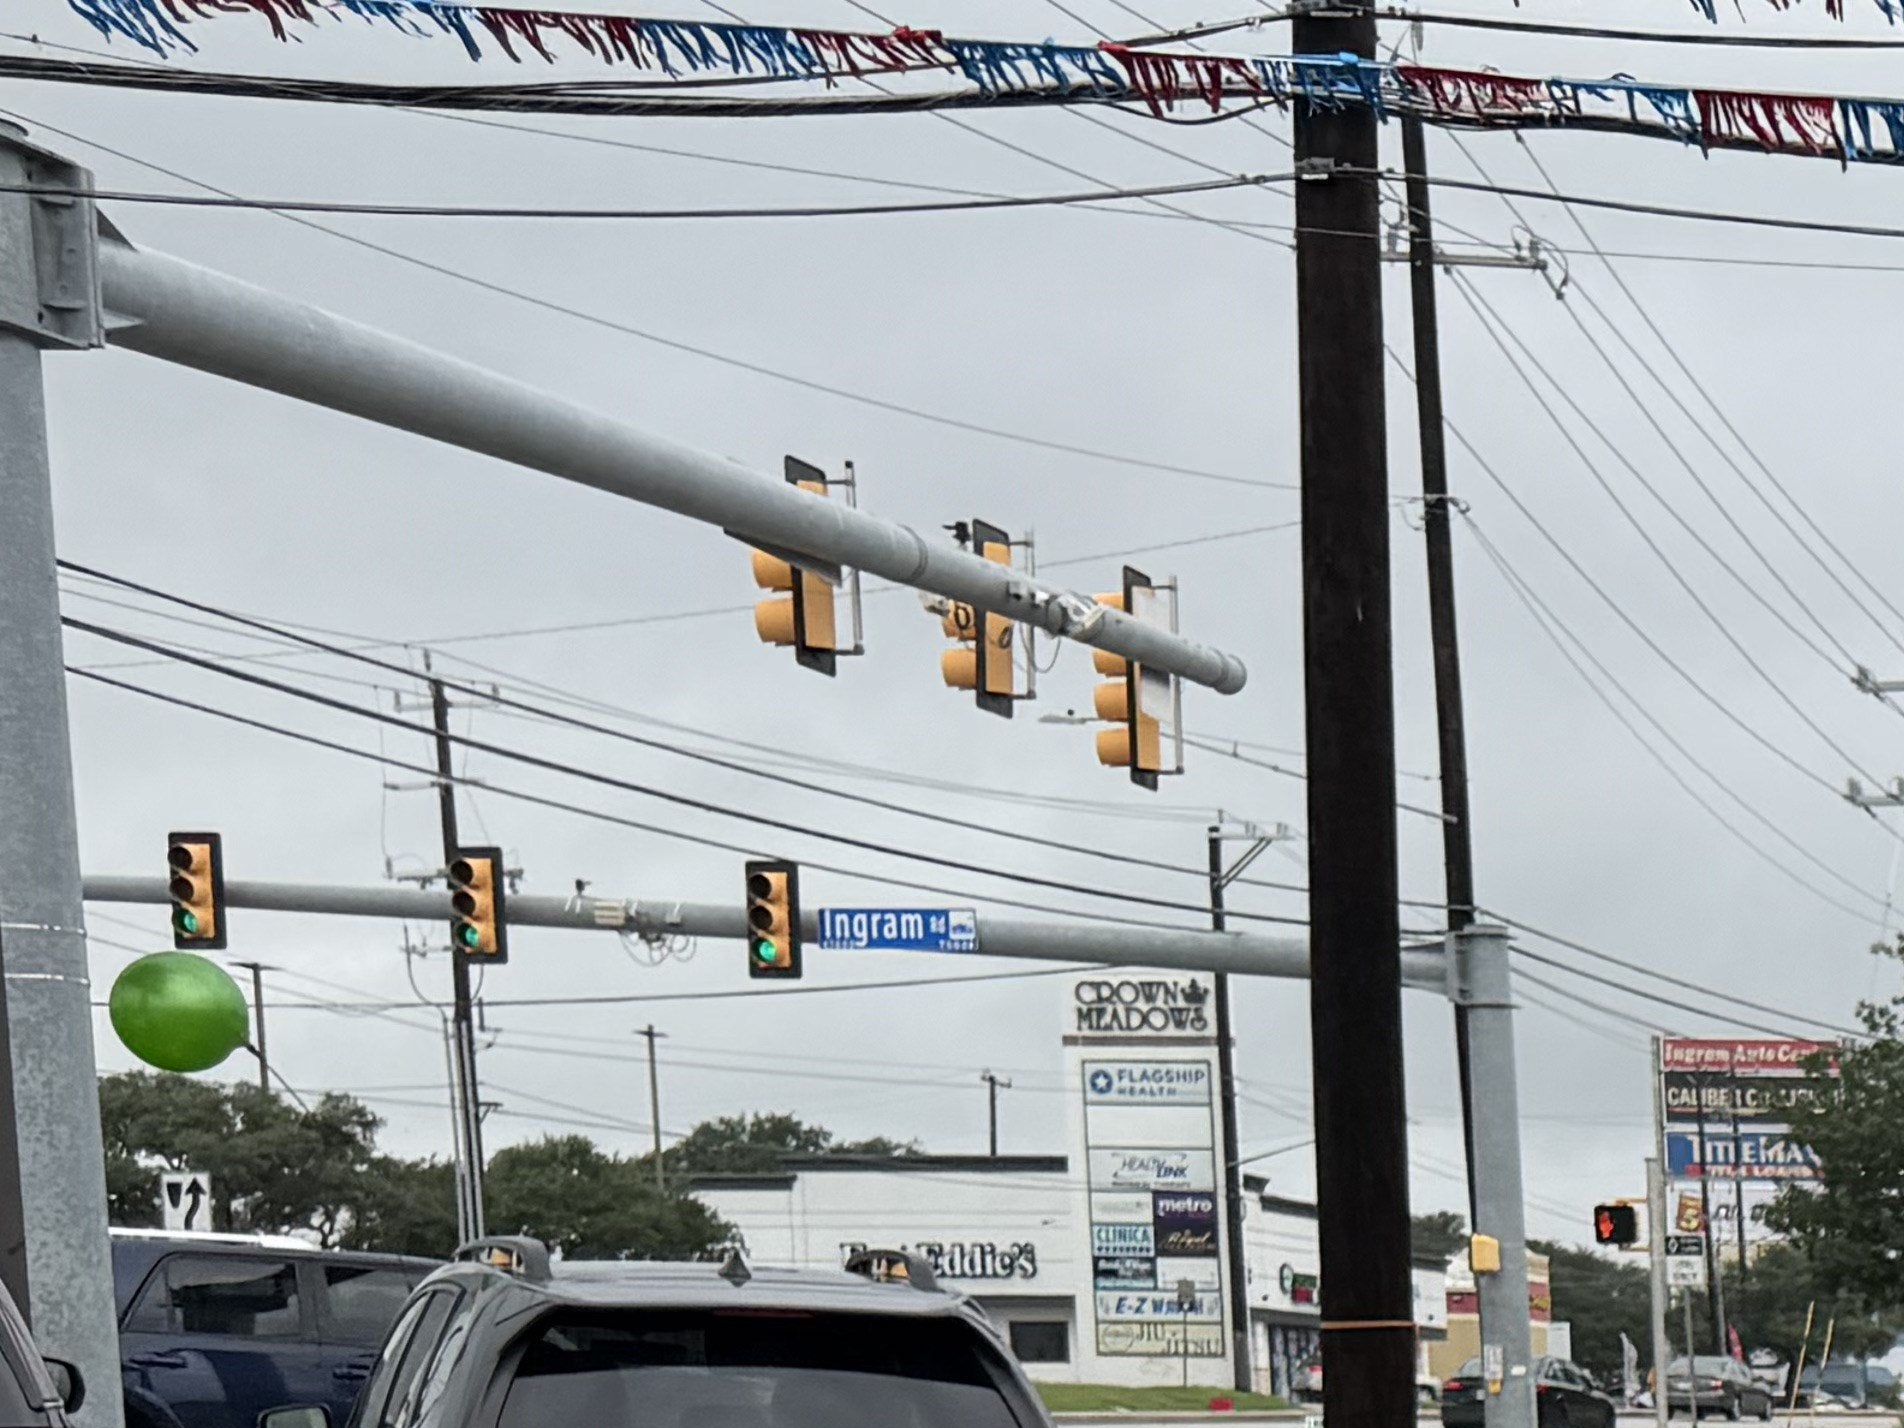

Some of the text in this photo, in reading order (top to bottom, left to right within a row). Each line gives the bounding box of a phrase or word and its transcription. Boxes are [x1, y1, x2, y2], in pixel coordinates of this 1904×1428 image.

[823, 908, 924, 947] Ingram
[1074, 980, 1179, 1005] CROWN
[1076, 1006, 1208, 1031] MEADOWS
[1665, 1043, 1731, 1066] Ingram
[1117, 1068, 1205, 1084] FLAGSHIP
[1117, 1086, 1178, 1096] HEALTH
[1096, 1228, 1150, 1242] CLINICA
